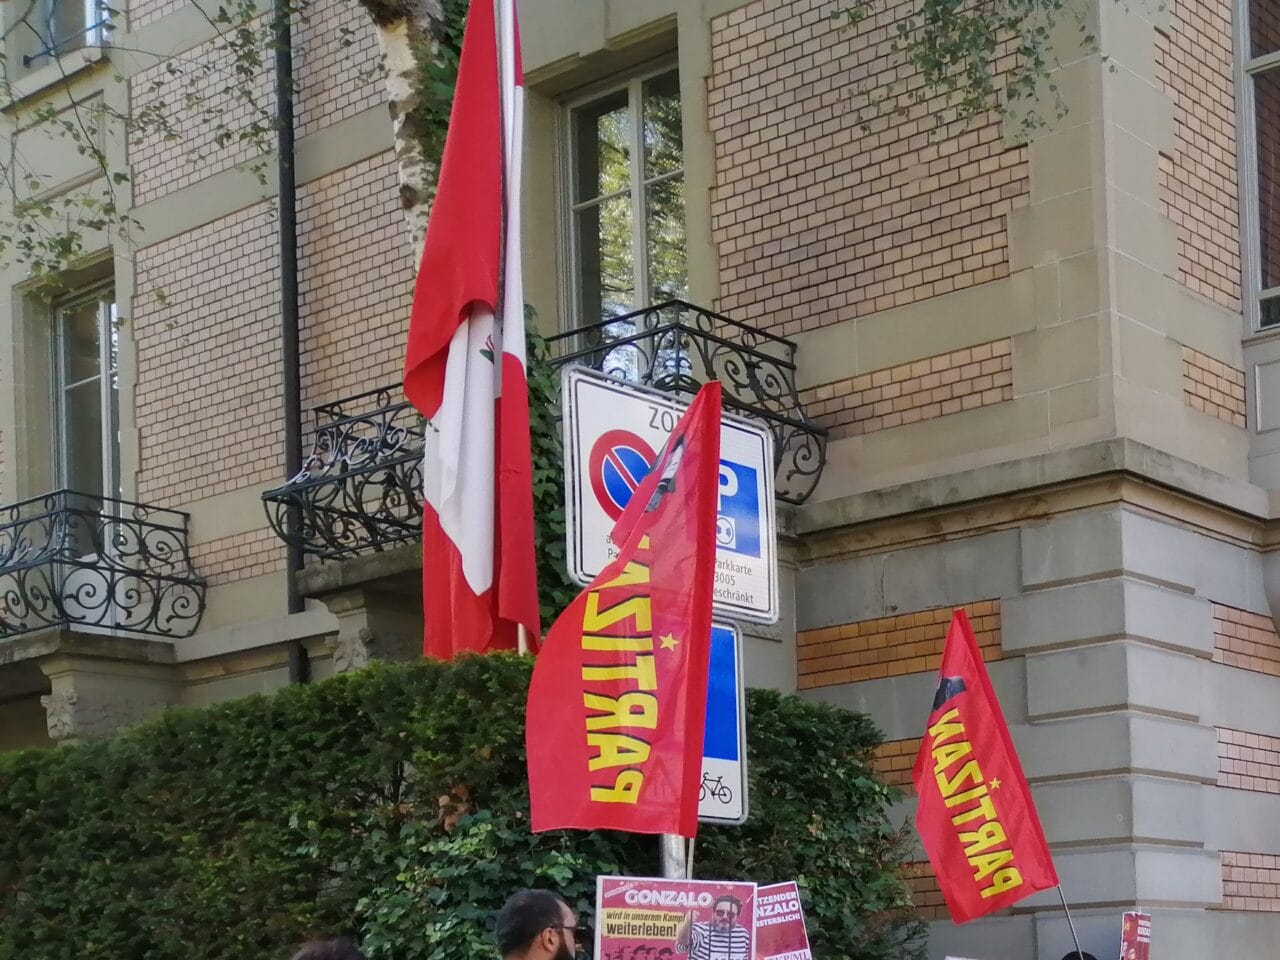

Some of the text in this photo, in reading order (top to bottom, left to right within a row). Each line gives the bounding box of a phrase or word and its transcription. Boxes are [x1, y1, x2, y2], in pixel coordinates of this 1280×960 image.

[715, 560, 752, 576] arkkarte
[624, 889, 714, 907] GONZALO
[606, 911, 622, 920] wird
[623, 912, 631, 921] in
[631, 913, 662, 921] unserem
[606, 921, 677, 937] weiterleben!
